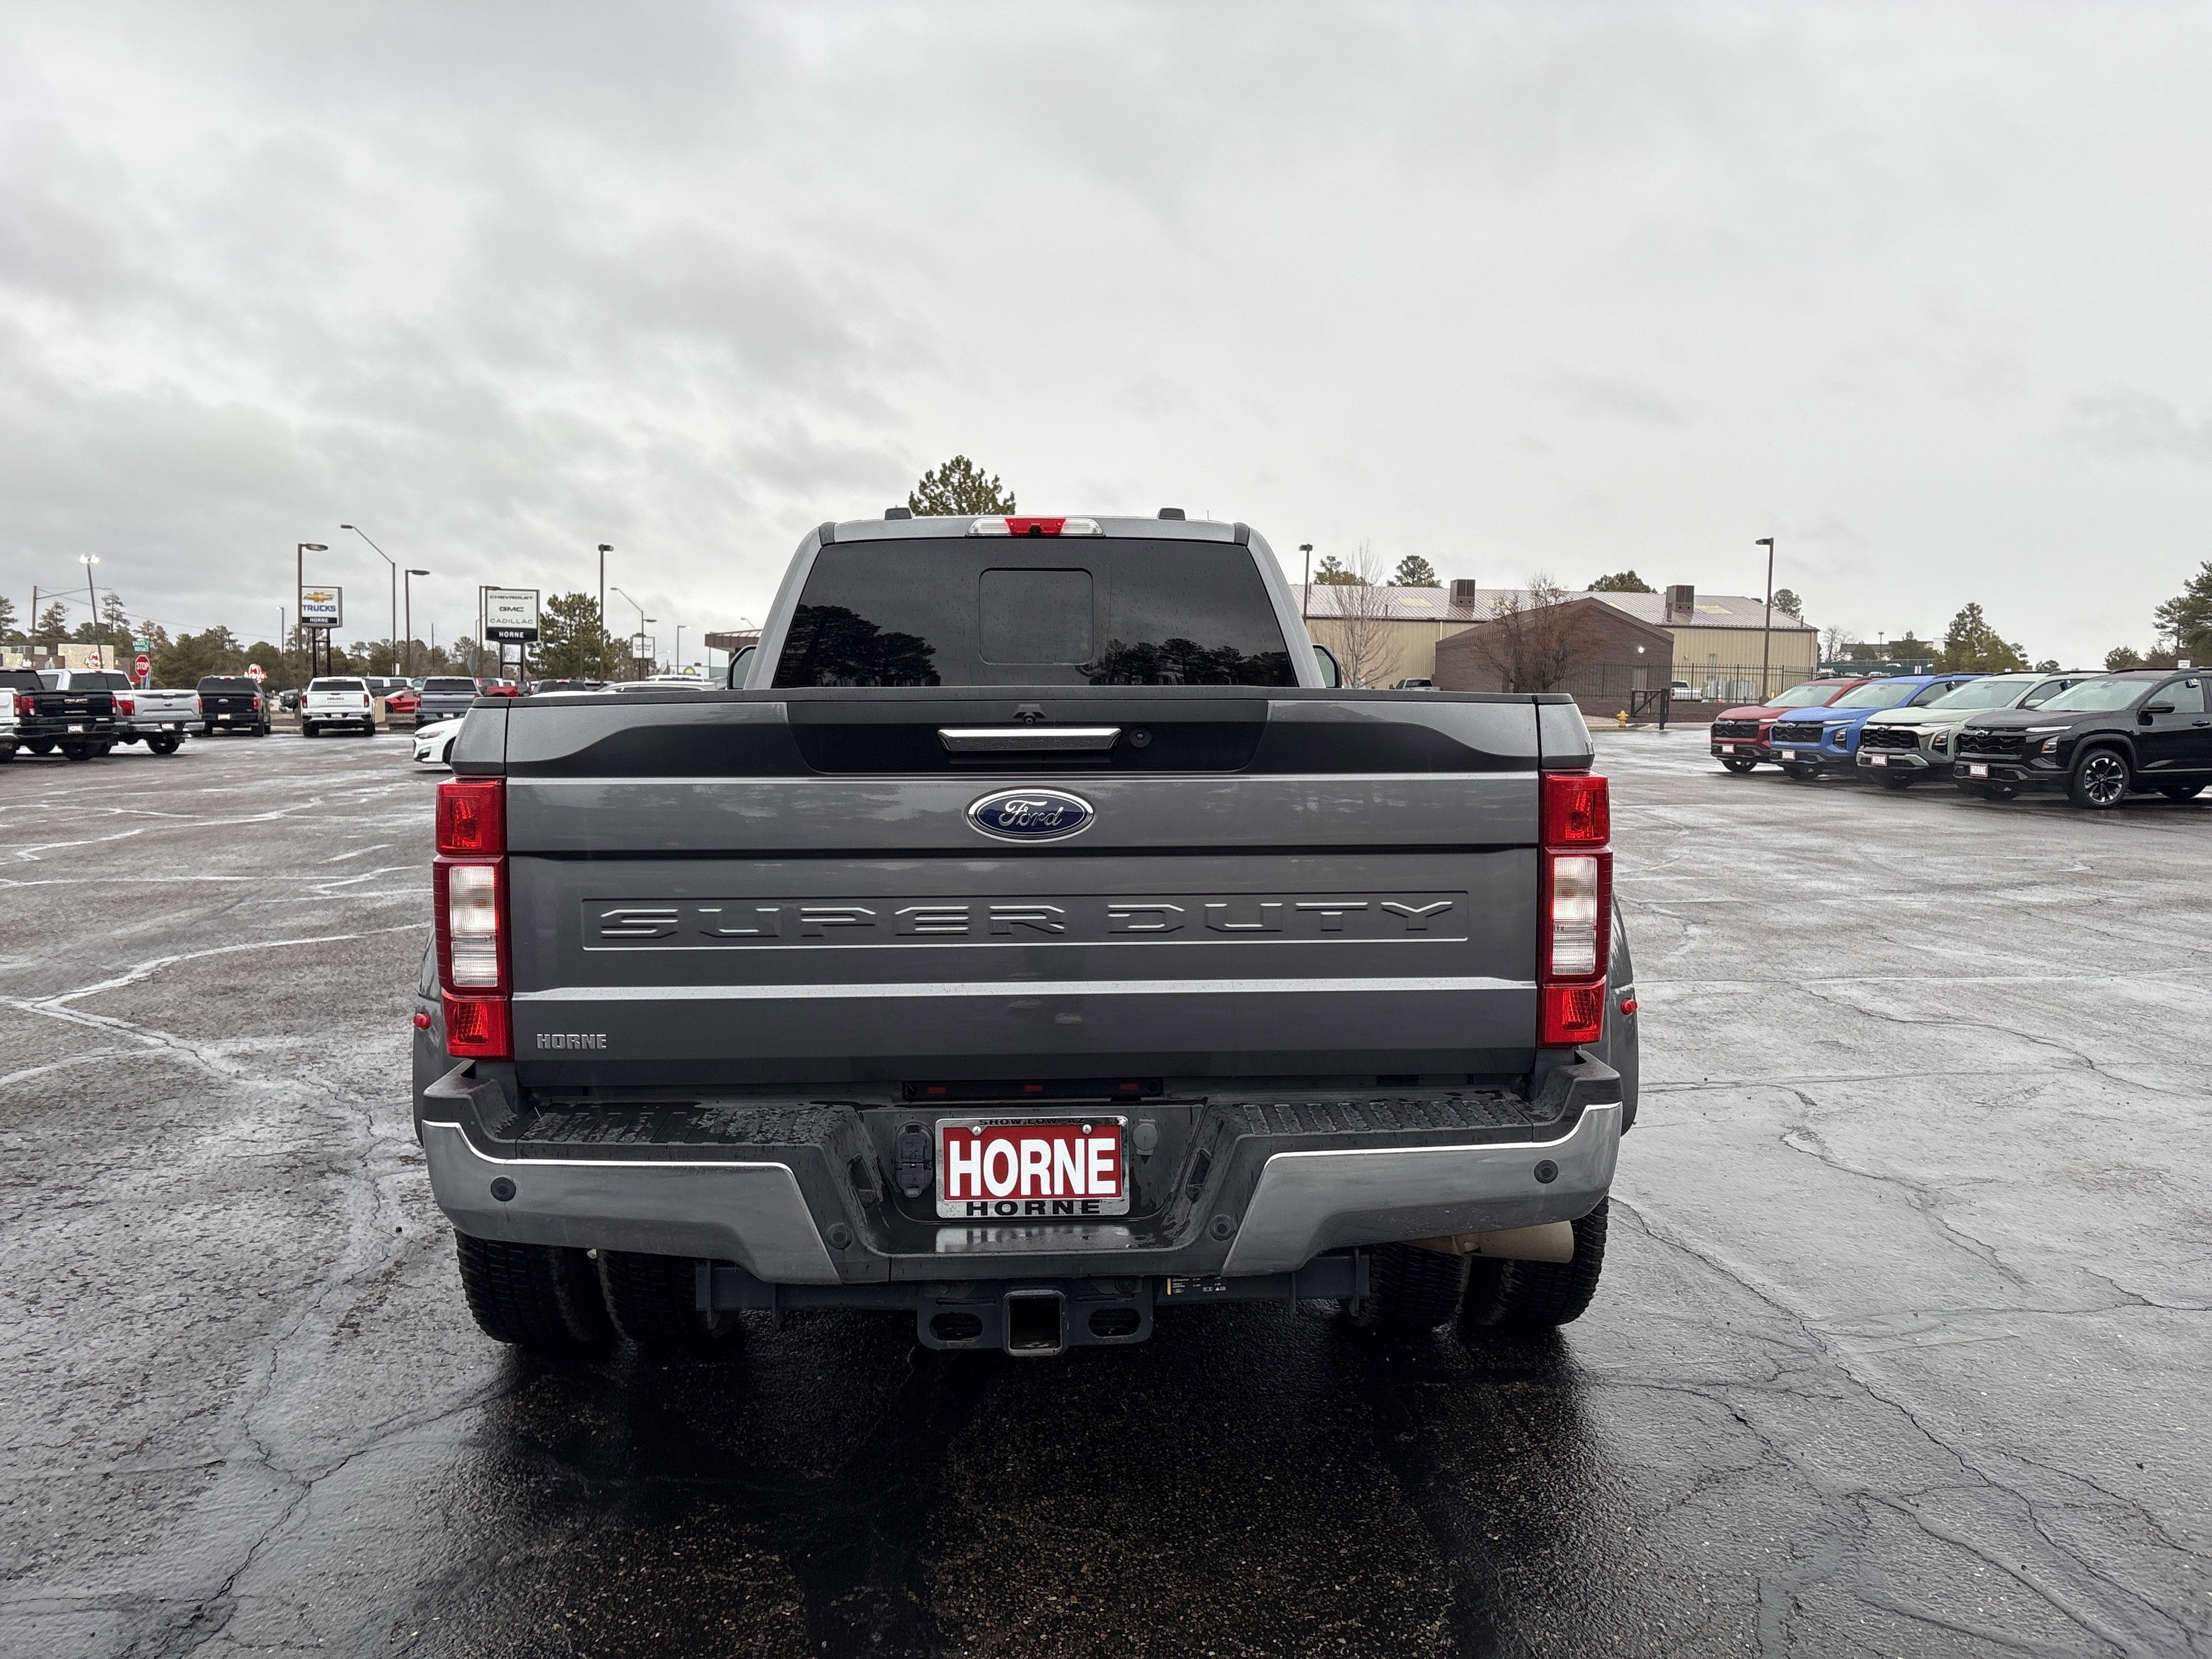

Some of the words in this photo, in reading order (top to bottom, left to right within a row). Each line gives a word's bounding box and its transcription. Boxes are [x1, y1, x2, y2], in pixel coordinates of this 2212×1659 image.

[136, 661, 149, 670] STOP
[998, 800, 1064, 827] Ford
[600, 904, 1065, 939] SUPER
[1107, 901, 1454, 933] DUTY
[536, 1033, 607, 1049] HORNE
[949, 1137, 1116, 1197] HORNE
[966, 1200, 1101, 1216] HORNE
